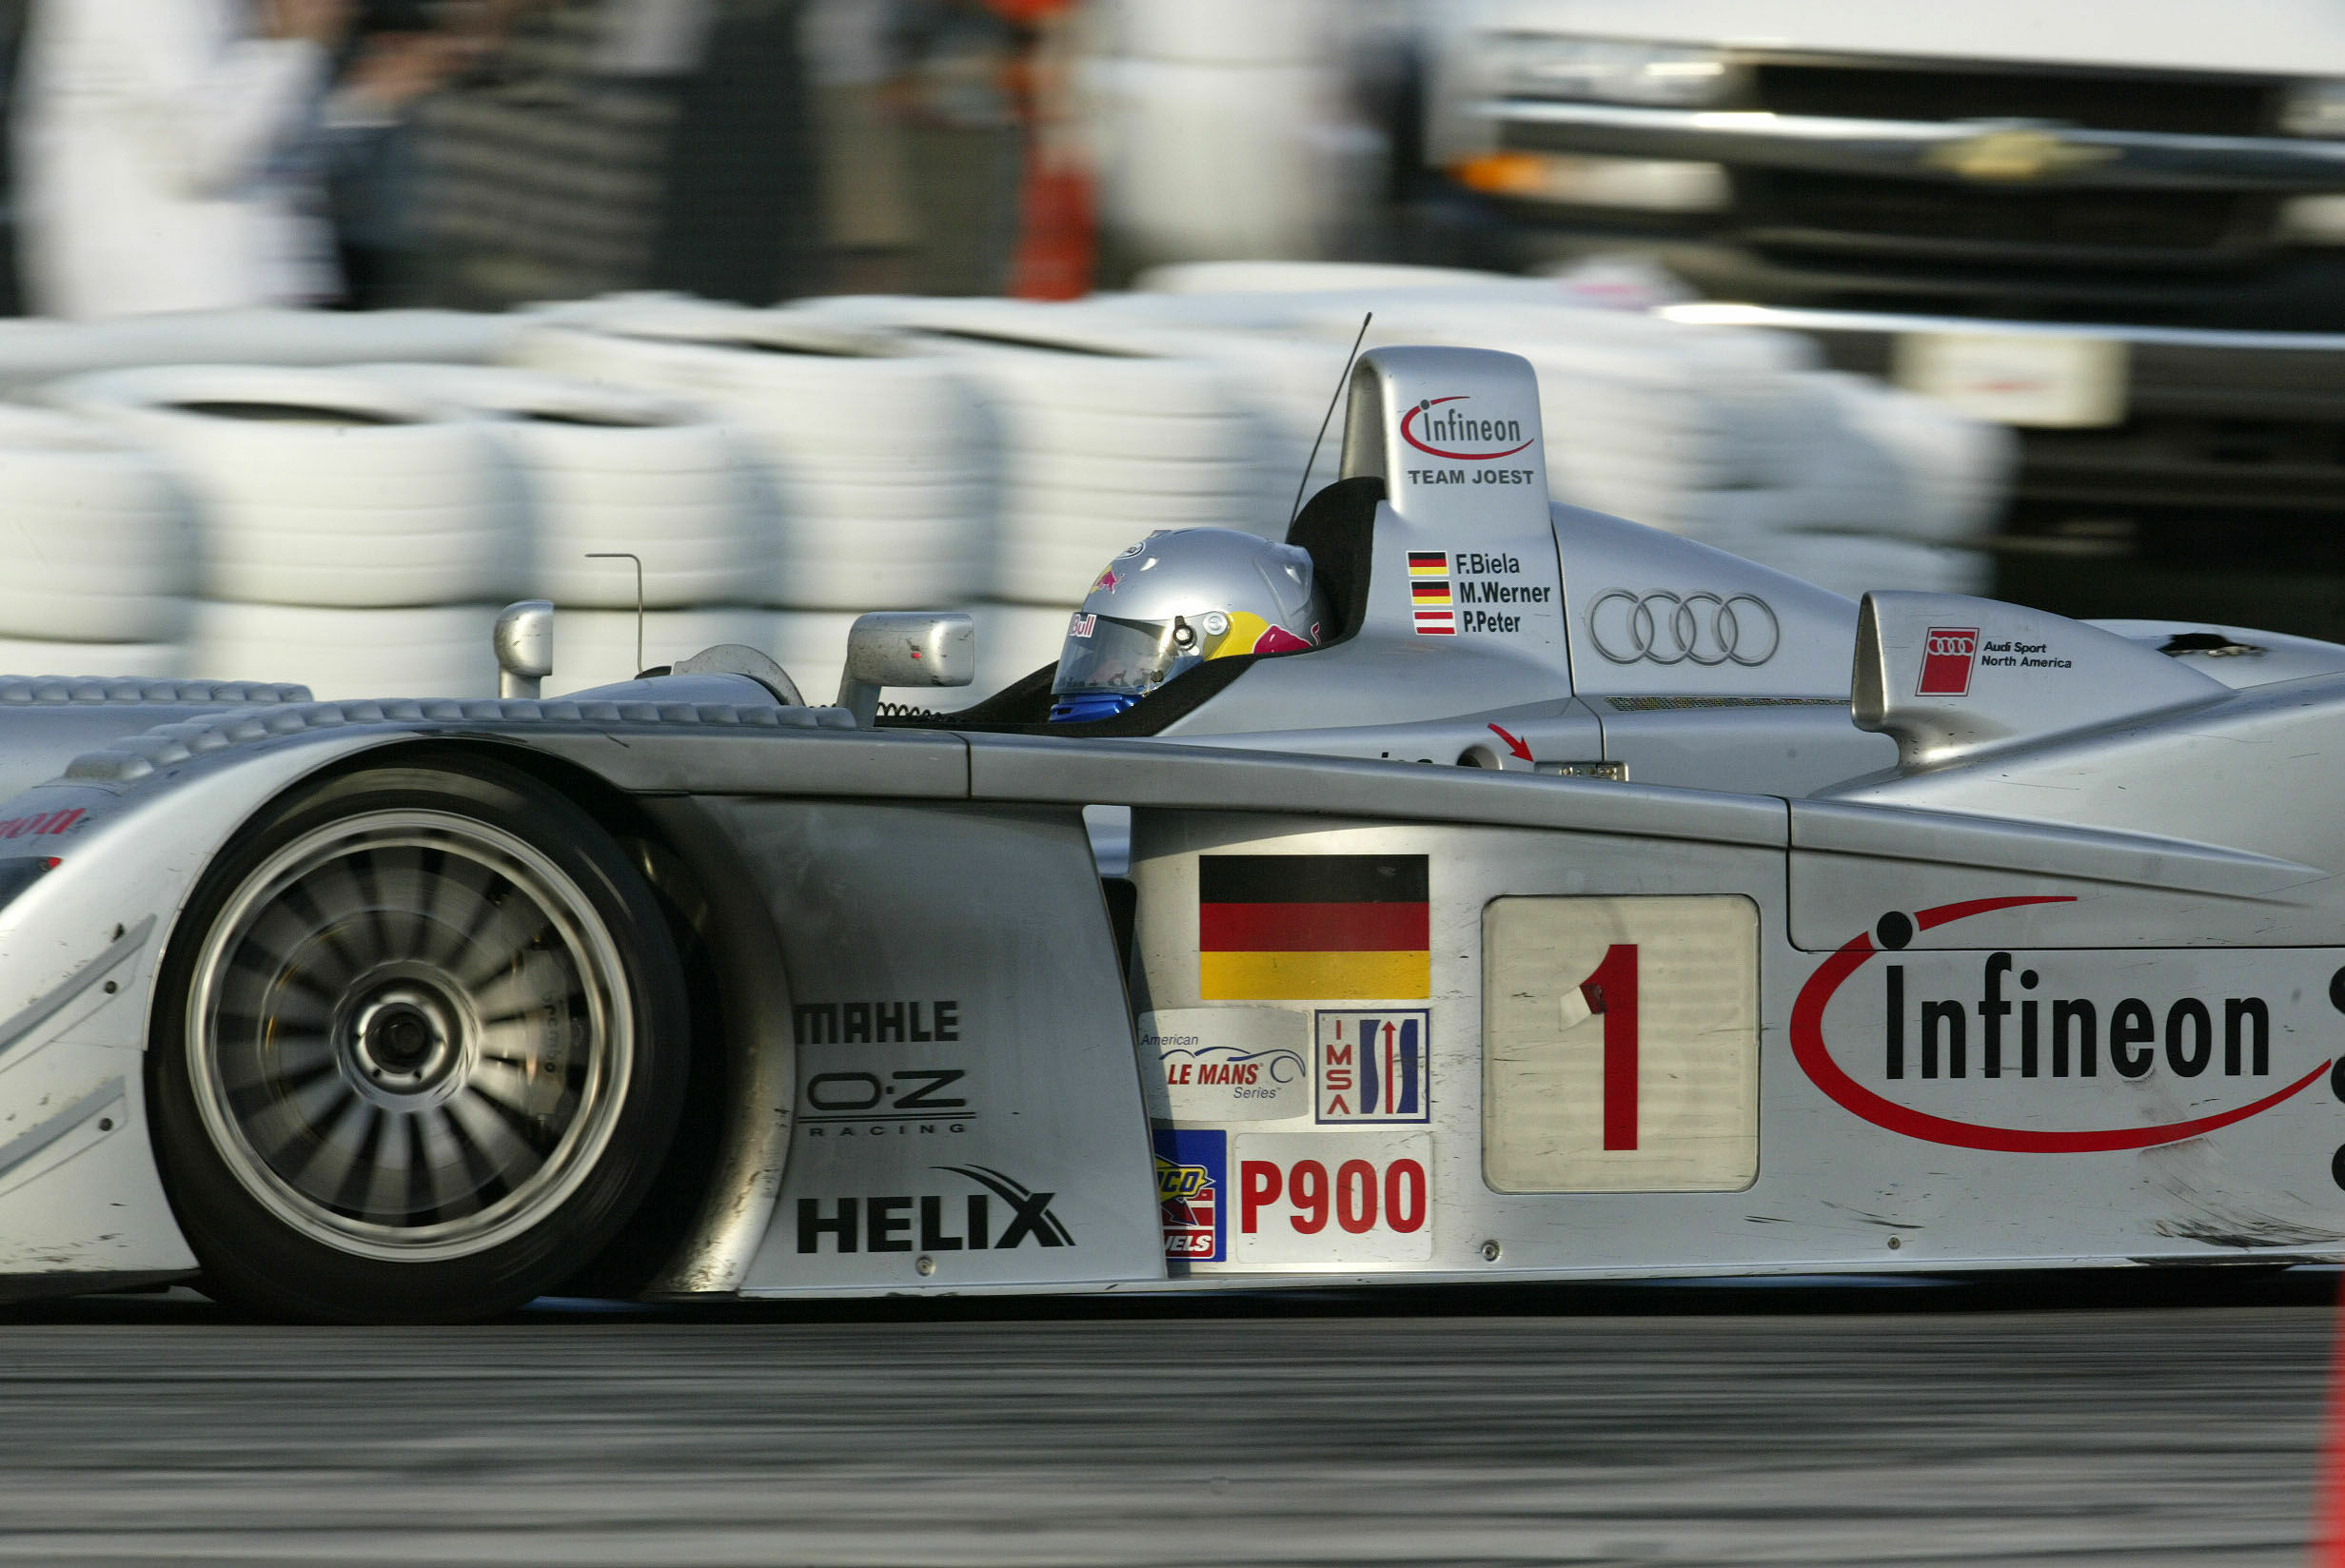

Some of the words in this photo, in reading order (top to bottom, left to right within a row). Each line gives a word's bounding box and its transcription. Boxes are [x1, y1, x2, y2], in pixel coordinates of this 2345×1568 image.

[1408, 470, 1465, 484] TEAM
[1472, 470, 1534, 484] JOEST
[1455, 553, 1521, 575] F.Biela
[1460, 581, 1551, 603] M.Werner
[1463, 611, 1521, 633] P.Peter
[1983, 640, 2012, 653] Audi
[2013, 641, 2047, 655] Sport
[1980, 655, 2017, 667] North
[2020, 656, 2072, 669] America
[794, 1001, 960, 1045] MAHLE
[1141, 1033, 1199, 1046] American
[1579, 944, 1638, 1150] 1
[1168, 1064, 1192, 1086] LE
[1197, 1063, 1259, 1086] MANS
[1326, 1020, 1352, 1115] IMSA
[1233, 1087, 1276, 1099] Series
[810, 1124, 967, 1138] RACING
[1241, 1159, 1427, 1235] P900
[798, 1192, 1076, 1254] HELIX
